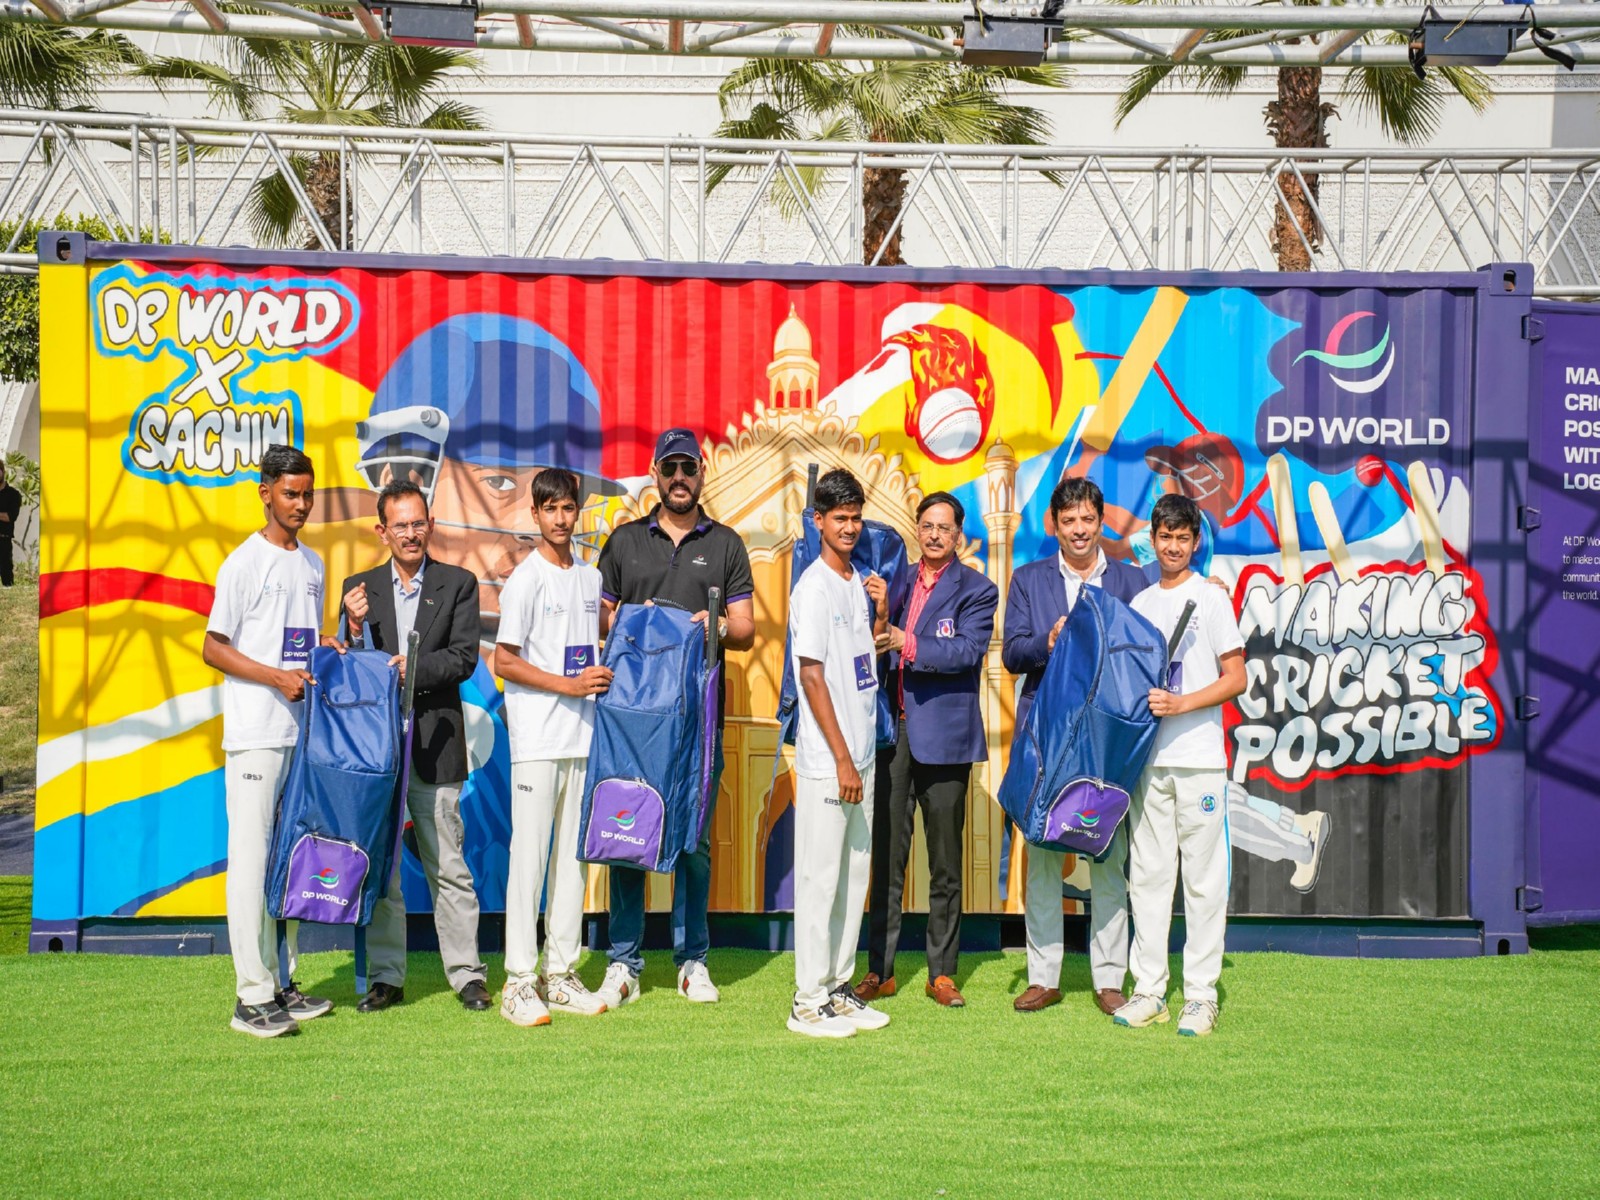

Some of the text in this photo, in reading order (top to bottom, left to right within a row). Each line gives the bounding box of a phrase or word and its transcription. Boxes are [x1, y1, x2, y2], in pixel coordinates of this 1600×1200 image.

[103, 287, 342, 350] DP WORLD
[171, 347, 244, 406] X
[1564, 393, 1600, 411] CRI
[131, 405, 289, 476] SACHIN
[1267, 416, 1450, 445] DP WORLD
[1563, 536, 1572, 546] At
[1573, 536, 1585, 546] DP
[1563, 554, 1571, 564] to
[1572, 554, 1593, 564] make
[1563, 590, 1599, 600] the world.
[1239, 570, 1467, 649] MAKING
[1237, 634, 1485, 719] CRICKET
[1232, 697, 1492, 783] POSSIBLE
[601, 830, 645, 845] DP WORLD
[1060, 822, 1074, 831] DP
[302, 890, 349, 906] DP WORLD
